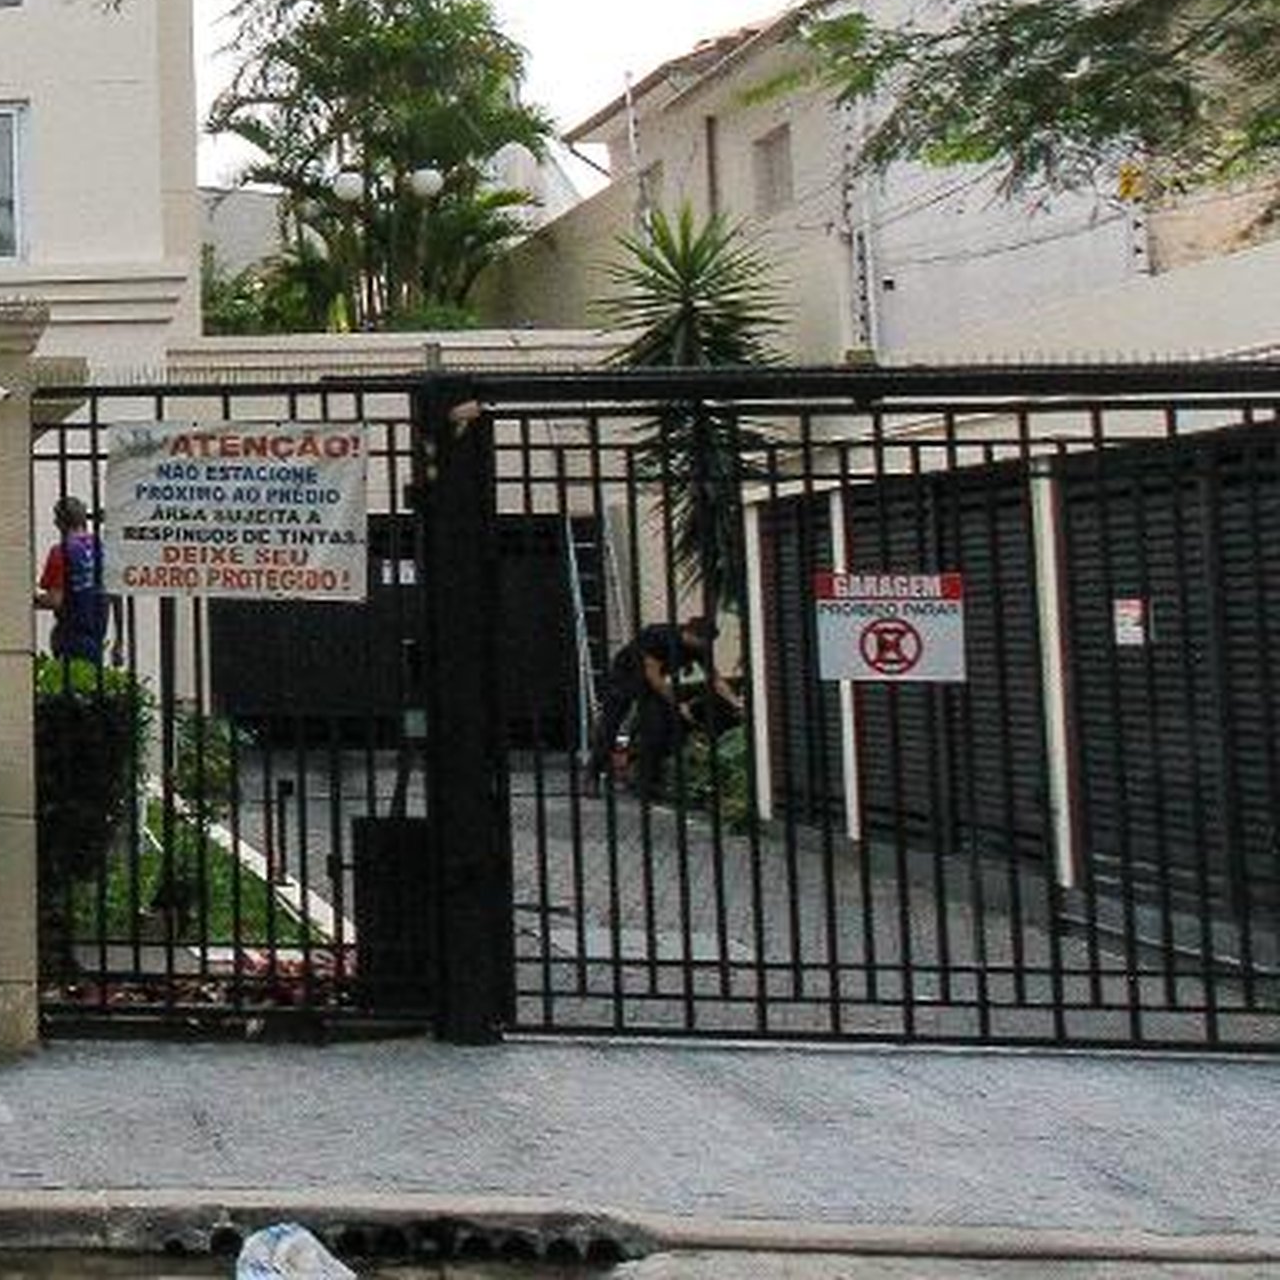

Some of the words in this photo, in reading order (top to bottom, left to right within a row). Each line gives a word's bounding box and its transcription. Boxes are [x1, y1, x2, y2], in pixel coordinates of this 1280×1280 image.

[206, 465, 318, 484] ESTACIONE
[123, 525, 238, 544] RESPINGOS
[243, 529, 271, 544] DE
[162, 546, 244, 565] DEIXE
[255, 548, 308, 566] SEU
[123, 566, 198, 588] CARRO
[833, 575, 941, 598] GARAGEM
